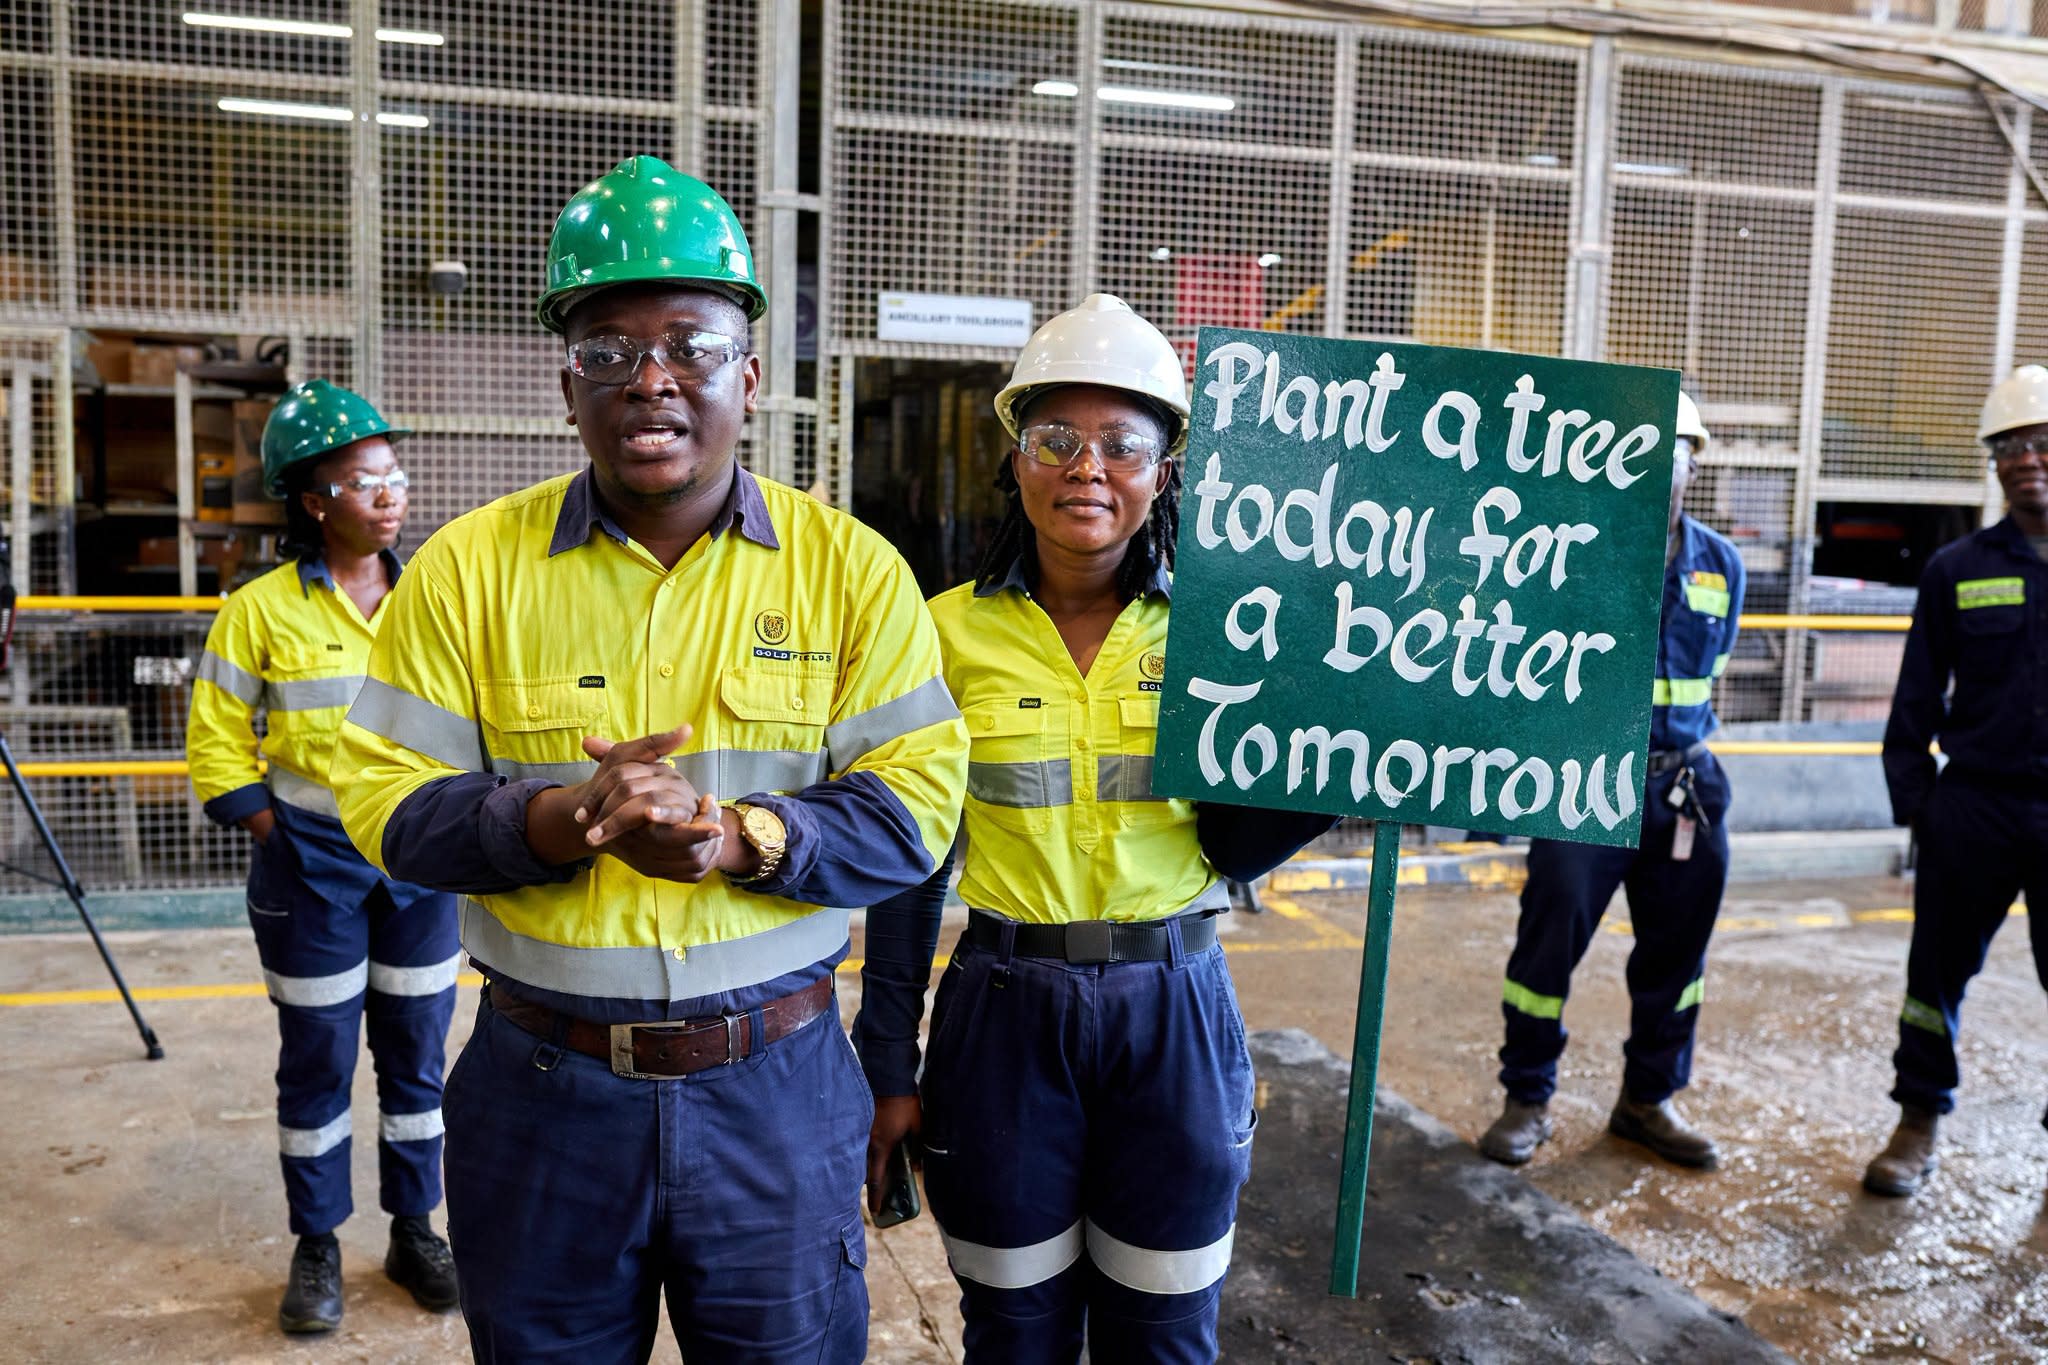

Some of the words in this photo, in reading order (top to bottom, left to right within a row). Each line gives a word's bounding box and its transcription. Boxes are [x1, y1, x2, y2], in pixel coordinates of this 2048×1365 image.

[1205, 341, 1407, 454] Plant
[1422, 391, 1482, 473] a
[1504, 374, 1661, 490] tree
[1194, 450, 1436, 601] today
[1459, 486, 1600, 593] for
[755, 649, 788, 659] GOLD
[792, 654, 832, 662] FIELDS
[1140, 682, 1161, 691] GOL
[1225, 586, 1283, 662] a
[1323, 581, 1617, 706] better
[1188, 677, 1638, 832] Tomorrow
